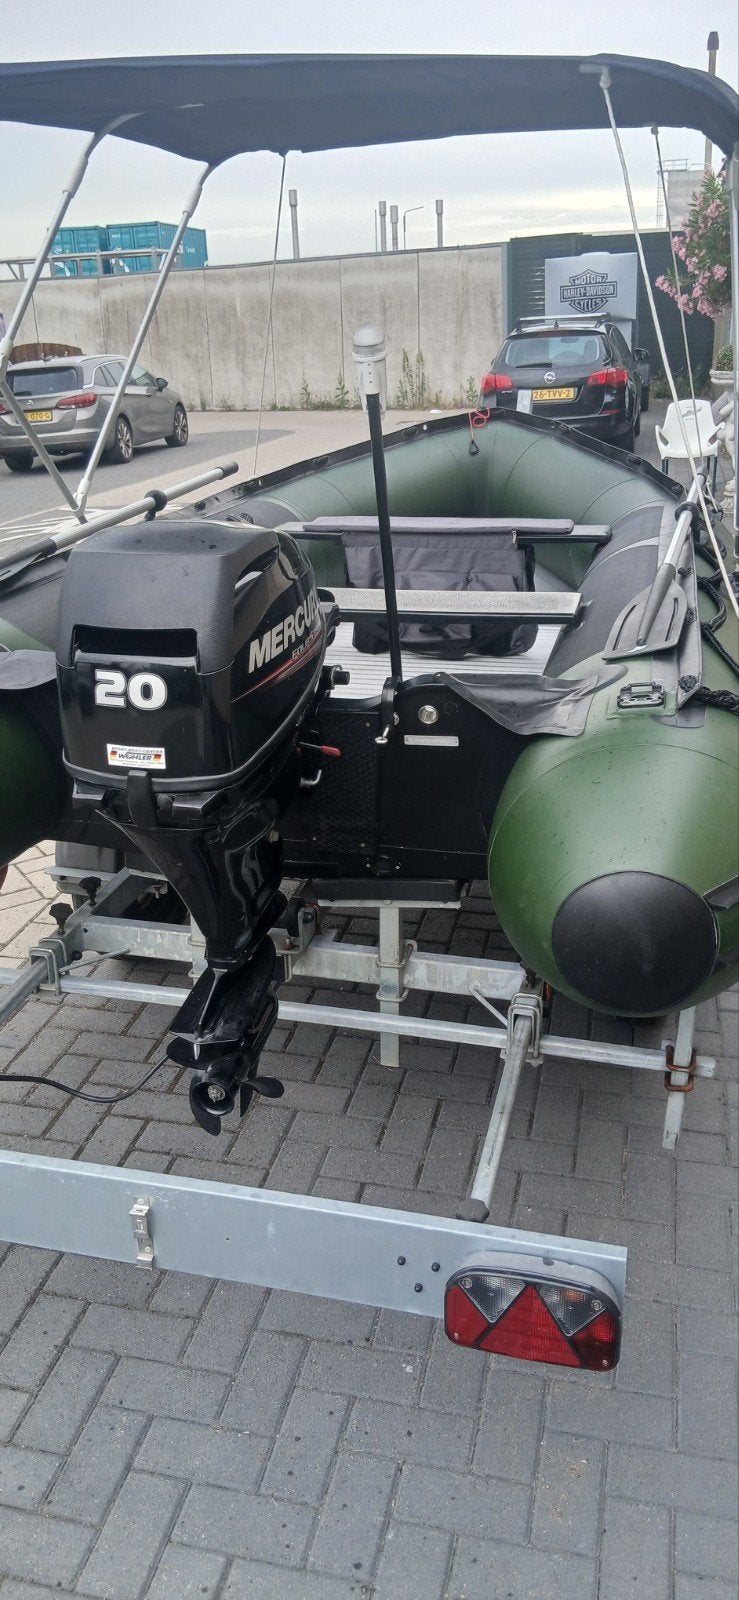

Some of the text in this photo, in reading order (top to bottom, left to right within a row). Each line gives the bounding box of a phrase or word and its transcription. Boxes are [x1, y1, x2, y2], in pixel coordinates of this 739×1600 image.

[575, 274, 604, 285] MOTOR
[563, 285, 614, 298] HARLEY-DAVIDSON
[575, 299, 602, 312] CYCLES
[248, 588, 320, 674] MERCUR
[94, 668, 168, 711] 20
